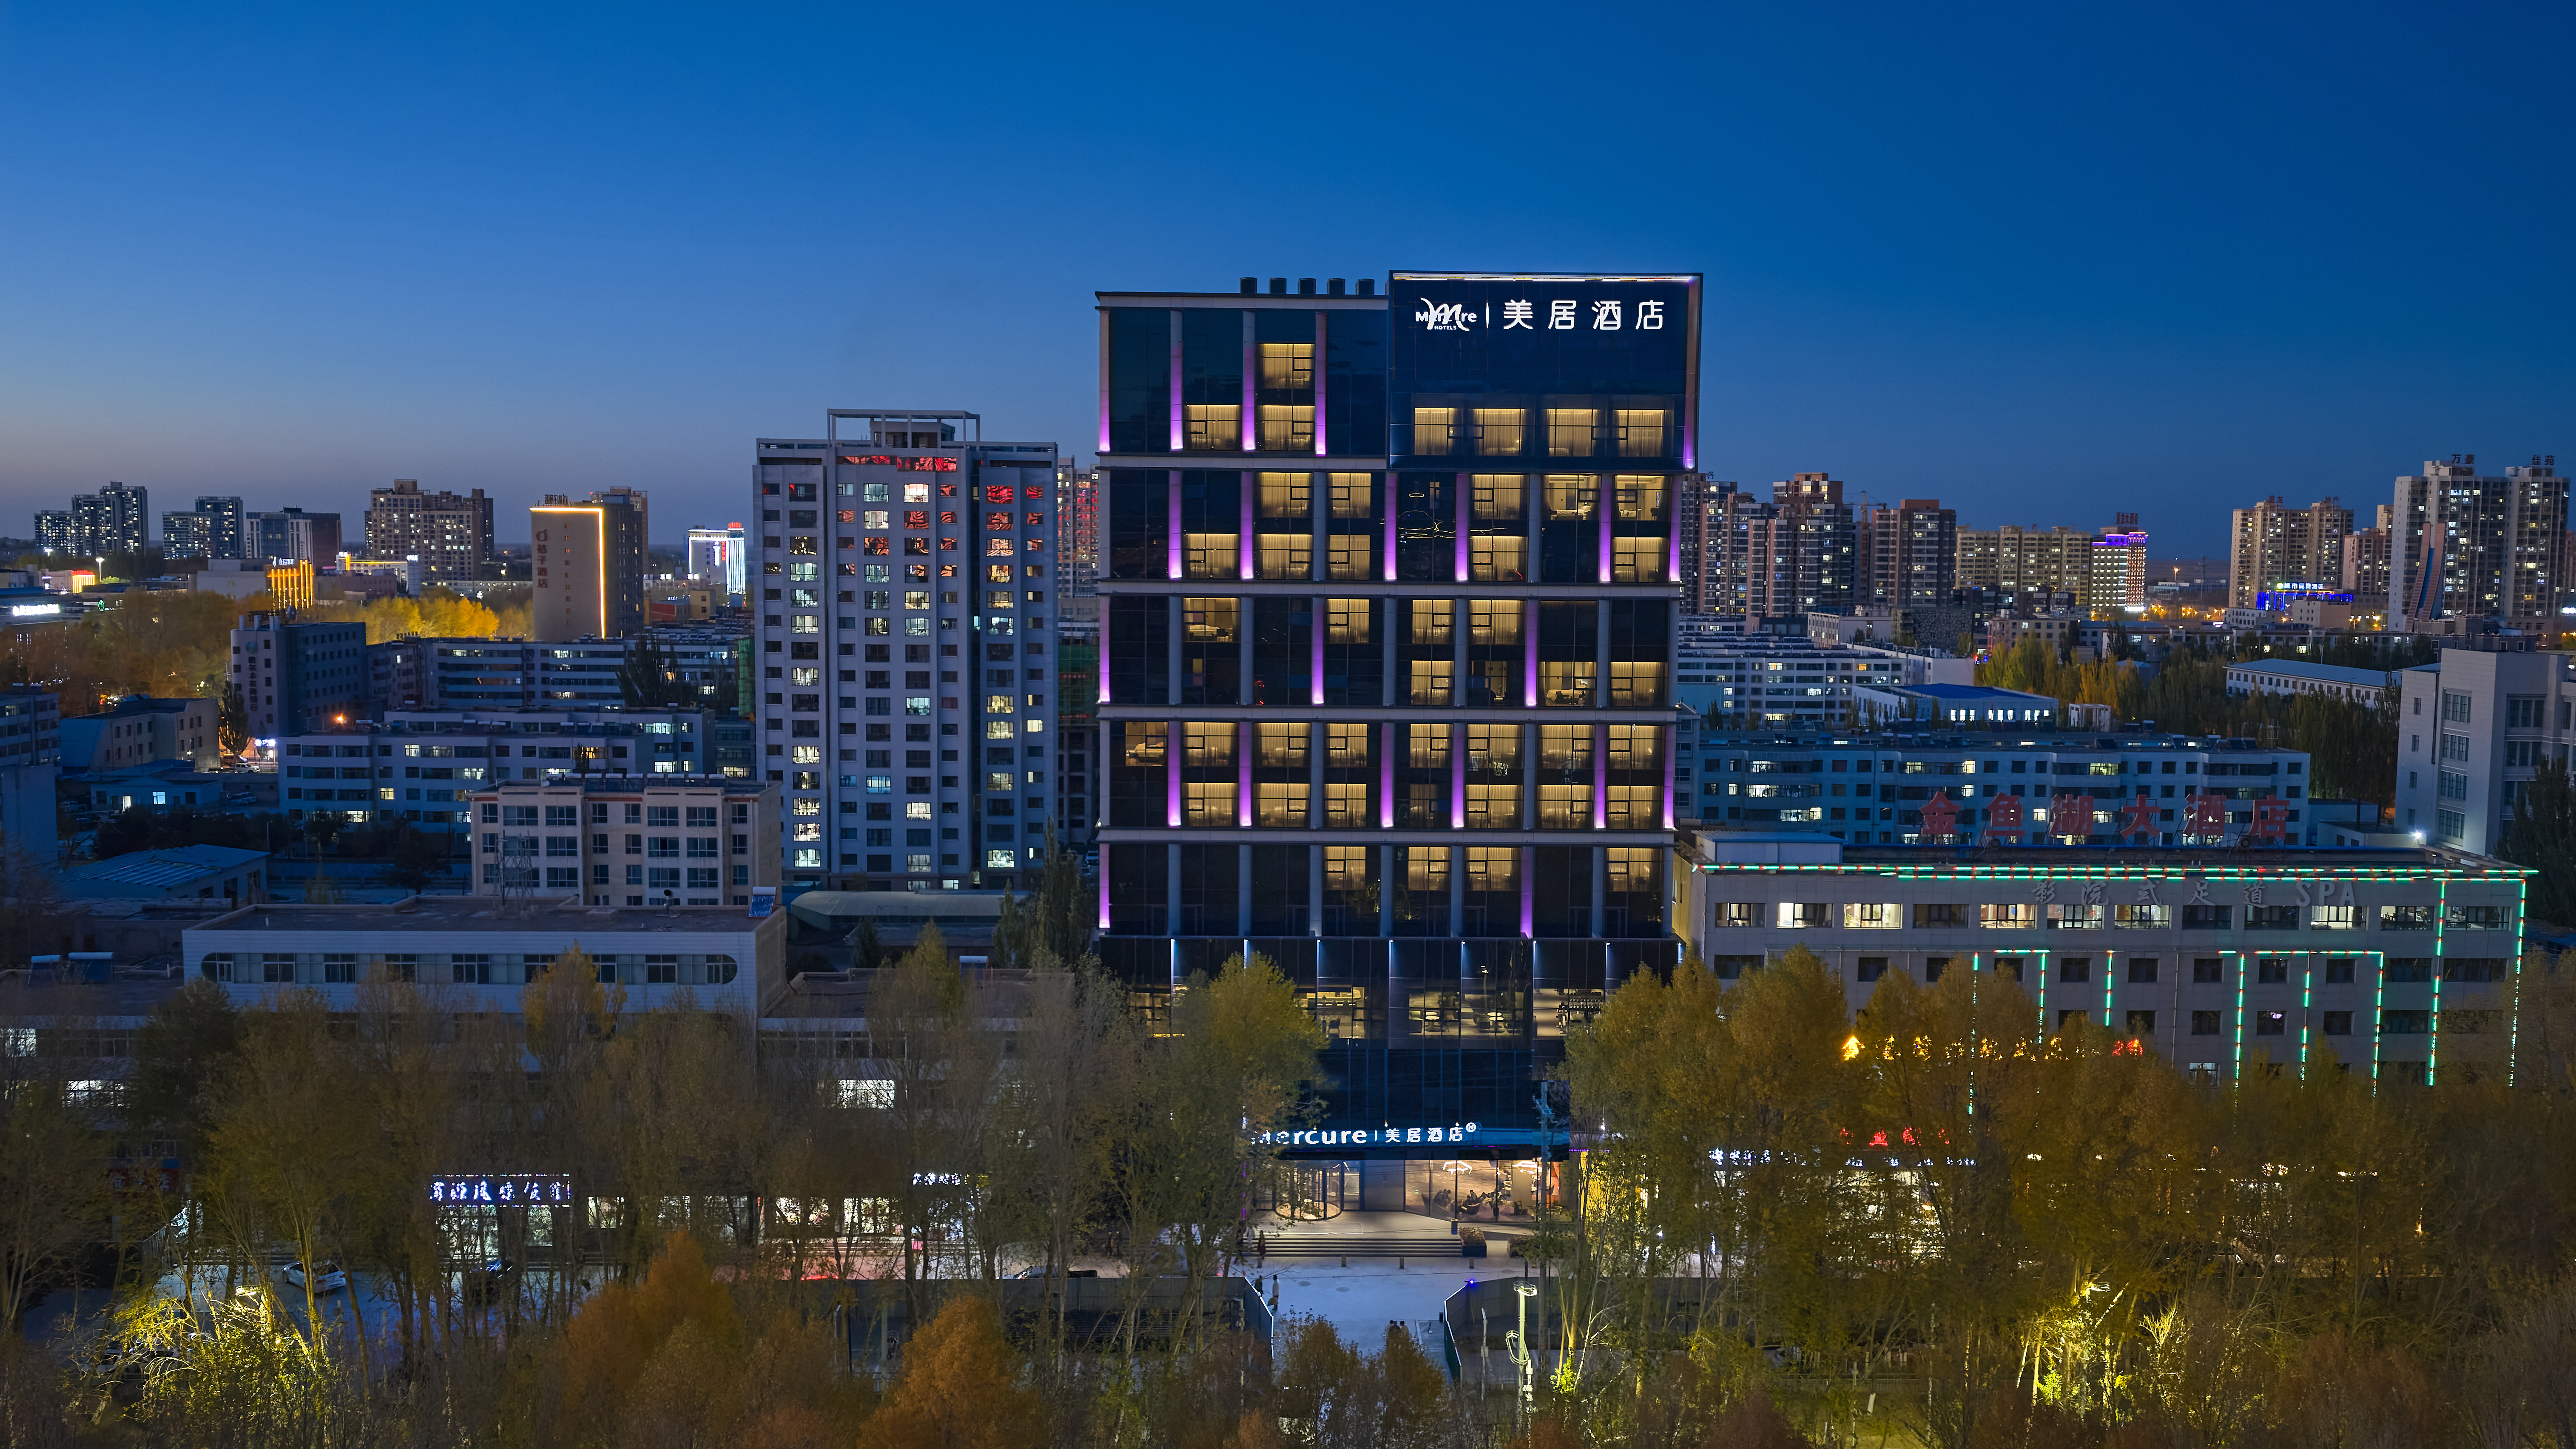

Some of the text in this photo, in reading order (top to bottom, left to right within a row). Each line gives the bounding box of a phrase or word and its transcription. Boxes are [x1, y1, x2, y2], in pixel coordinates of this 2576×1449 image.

[1503, 299, 1664, 330] 美居酒店
[1919, 791, 2290, 839] 金鱼湖大酒店
[2031, 879, 2357, 908] 影院式足道 SPA
[1385, 1127, 1463, 1143] 美居酒店
